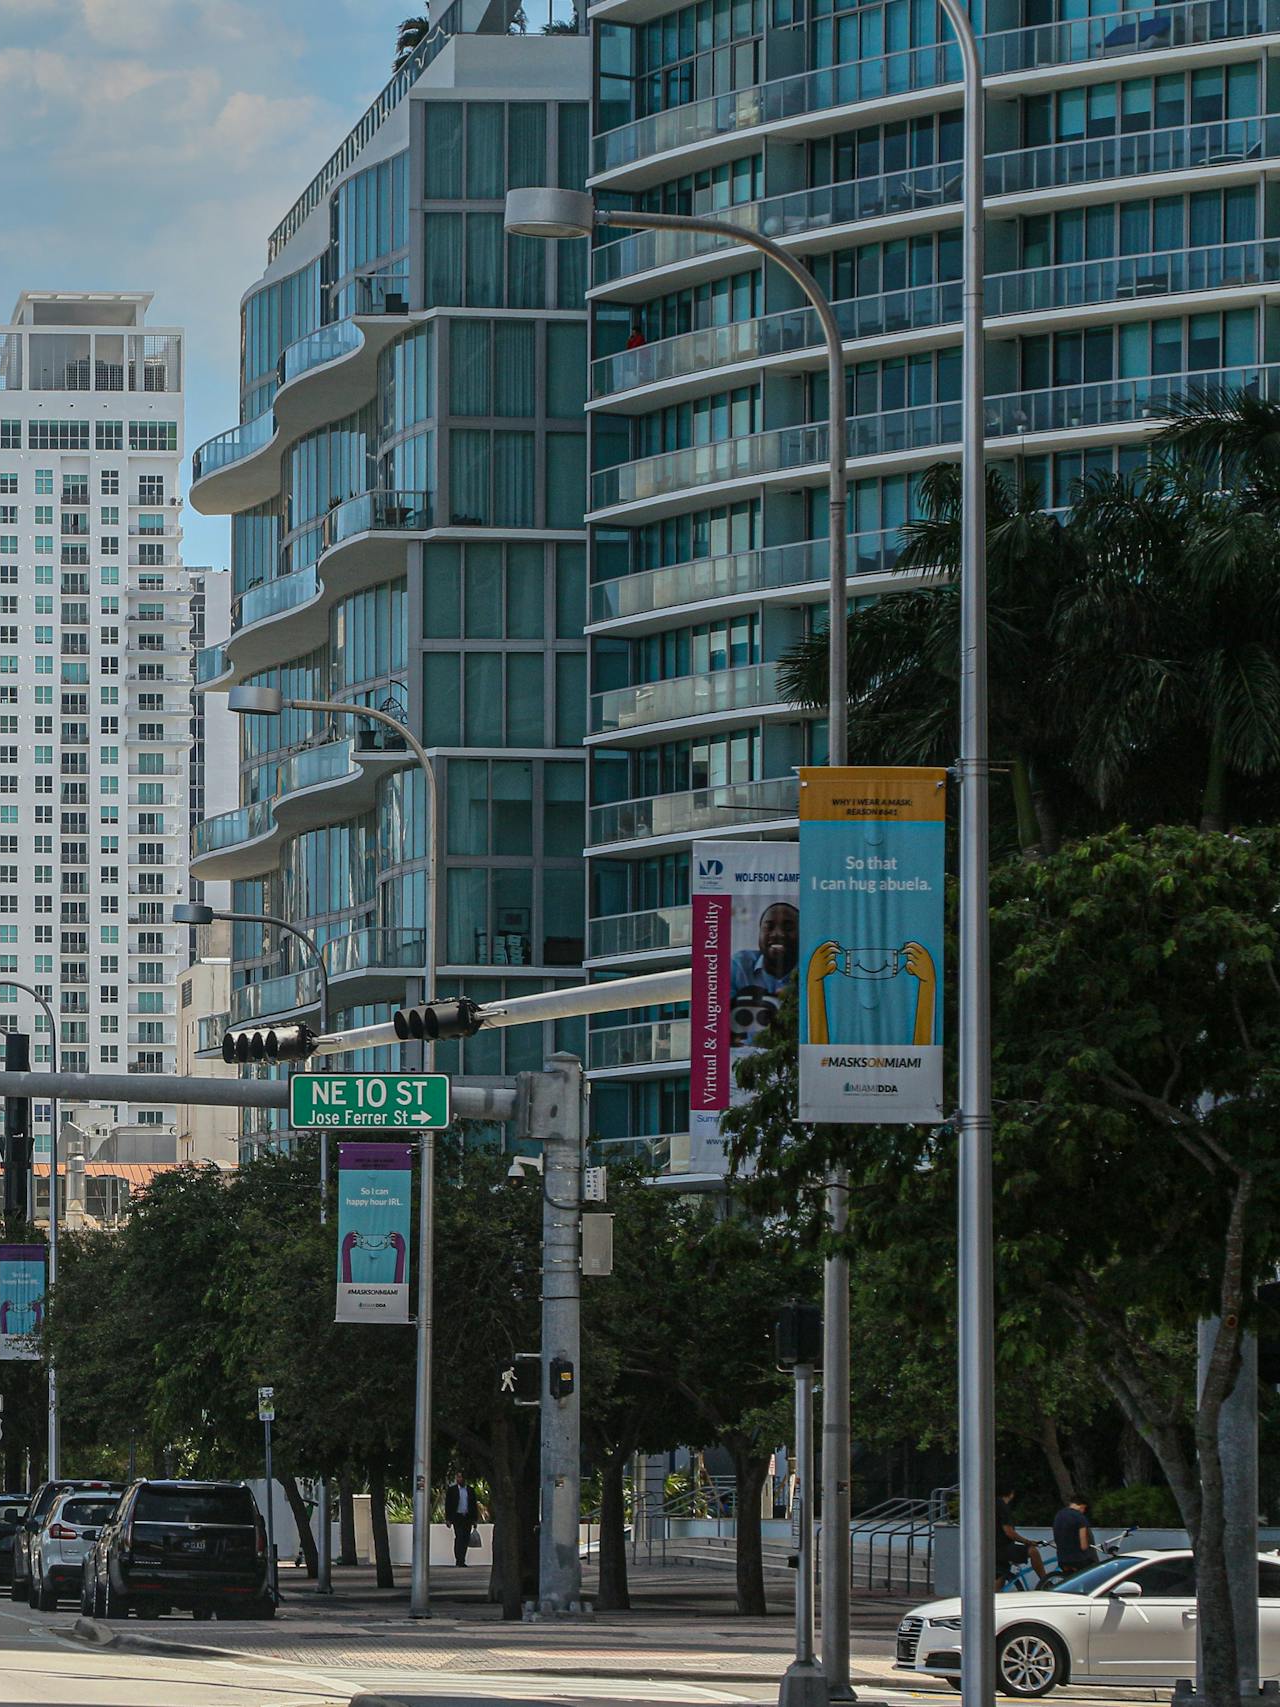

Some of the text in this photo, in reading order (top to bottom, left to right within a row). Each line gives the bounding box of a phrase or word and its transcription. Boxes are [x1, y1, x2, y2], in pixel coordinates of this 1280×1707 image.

[832, 798, 849, 806] WHY
[857, 798, 880, 806] WEAR
[847, 808, 877, 816] REASON
[845, 855, 898, 870] So that
[735, 873, 775, 882] WOLFSON
[812, 876, 932, 893] I can hug abuela.
[704, 902, 723, 949] Reality
[704, 954, 721, 1033] Augmented
[704, 1038, 717, 1050] &
[821, 1057, 922, 1068] #MASKSONMIAMI
[703, 1054, 717, 1104] Virtual
[312, 1078, 428, 1107] NE 10 ST
[308, 1110, 409, 1125] Jose Ferrer St
[361, 1187, 370, 1195] So
[346, 1198, 369, 1207] happy
[370, 1198, 387, 1206] hour
